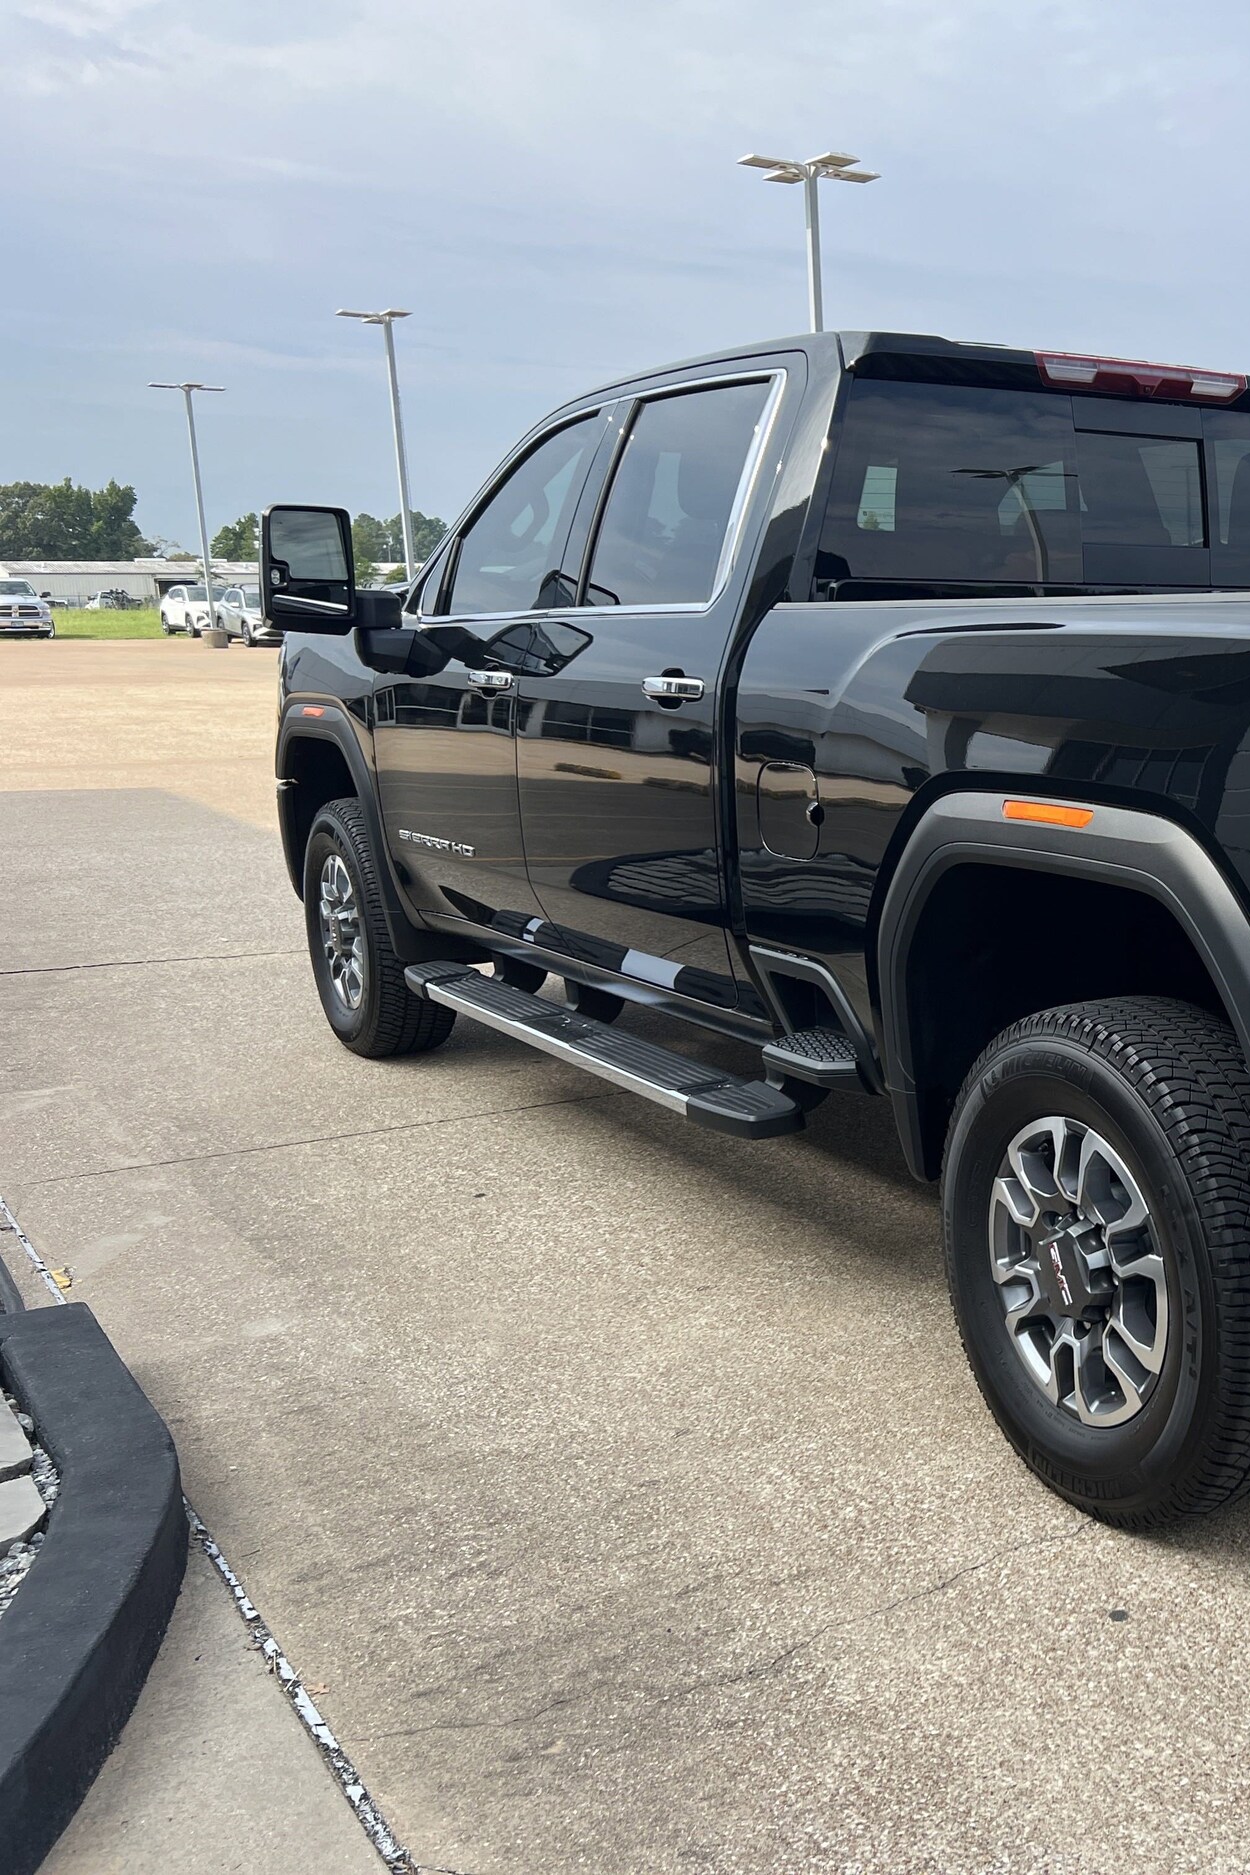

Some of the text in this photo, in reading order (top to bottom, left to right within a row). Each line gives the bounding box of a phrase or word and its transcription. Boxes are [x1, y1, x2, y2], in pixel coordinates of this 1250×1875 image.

[399, 829, 476, 857] SIERRA HD
[1001, 1050, 1088, 1083] MICHELIN
[1048, 1241, 1073, 1306] GMC
